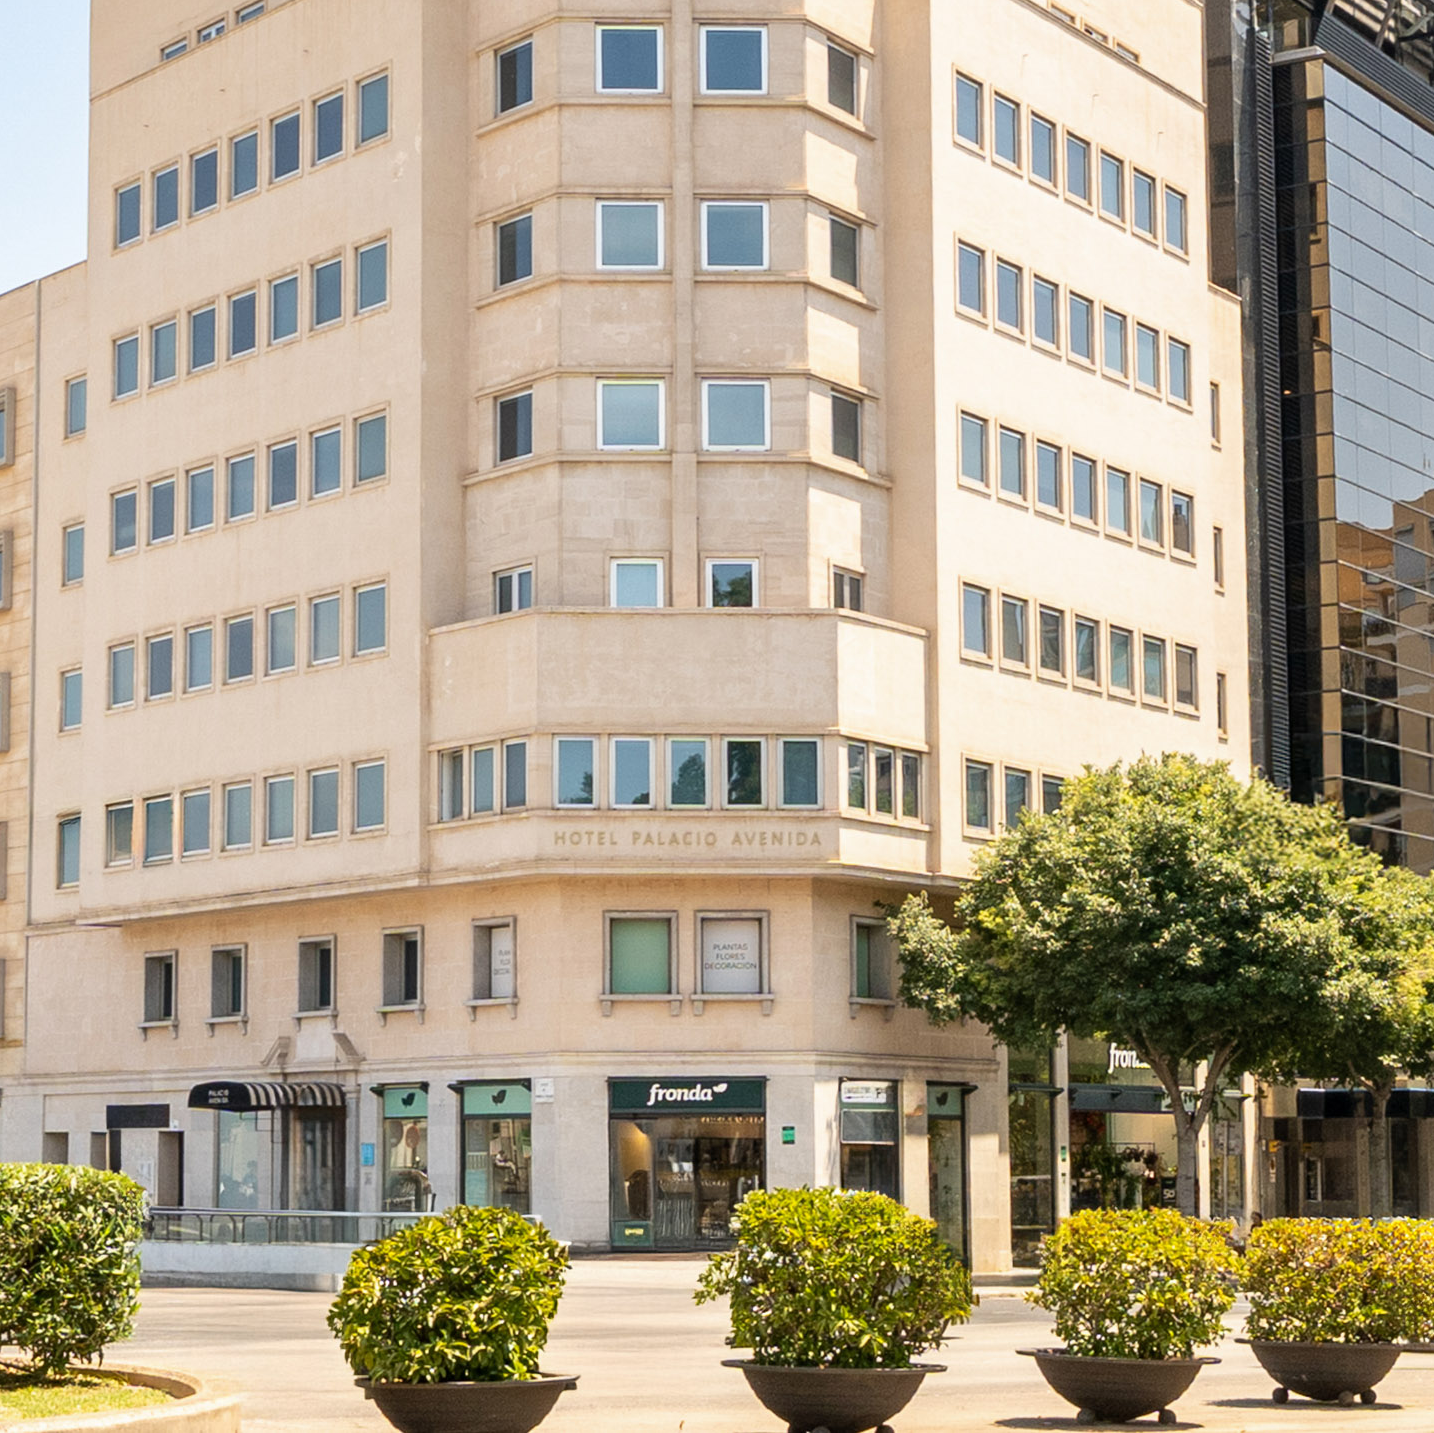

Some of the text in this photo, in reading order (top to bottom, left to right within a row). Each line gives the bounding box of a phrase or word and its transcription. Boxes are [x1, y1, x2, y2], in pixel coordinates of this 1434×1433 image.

[554, 831, 823, 846] HOTEL PALACIO AVENIDA
[713, 943, 748, 951] PLANTAS
[716, 953, 746, 961] FLORES
[647, 1083, 713, 1106] fronda
